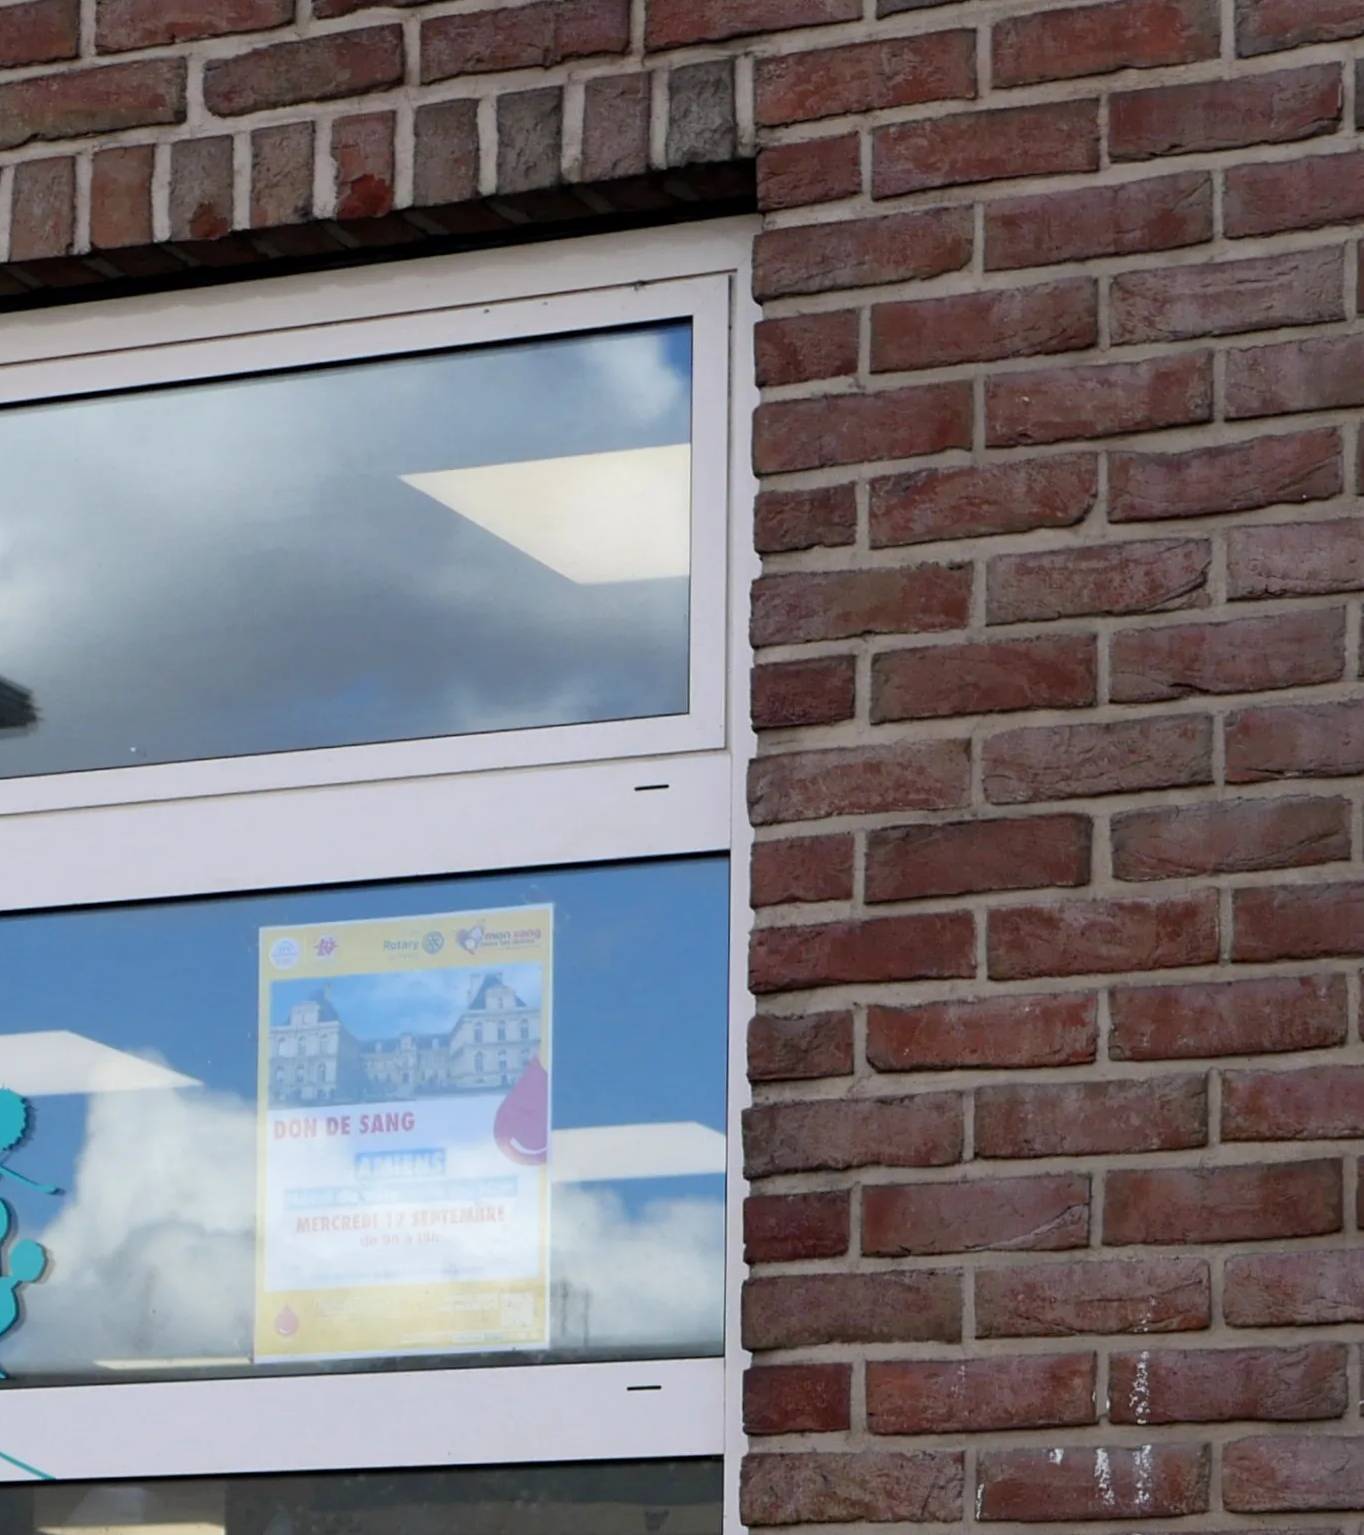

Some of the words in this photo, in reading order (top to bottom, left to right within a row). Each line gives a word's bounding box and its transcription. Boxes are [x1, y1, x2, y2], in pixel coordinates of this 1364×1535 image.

[383, 939, 420, 951] Rotary
[485, 931, 512, 940] mon
[513, 928, 542, 941] sang
[273, 1118, 318, 1141] DON
[326, 1115, 352, 1137] DE
[359, 1111, 416, 1135] SANG
[296, 1214, 379, 1234] MERCREDI
[410, 1205, 507, 1228] SEPTEMBRE
